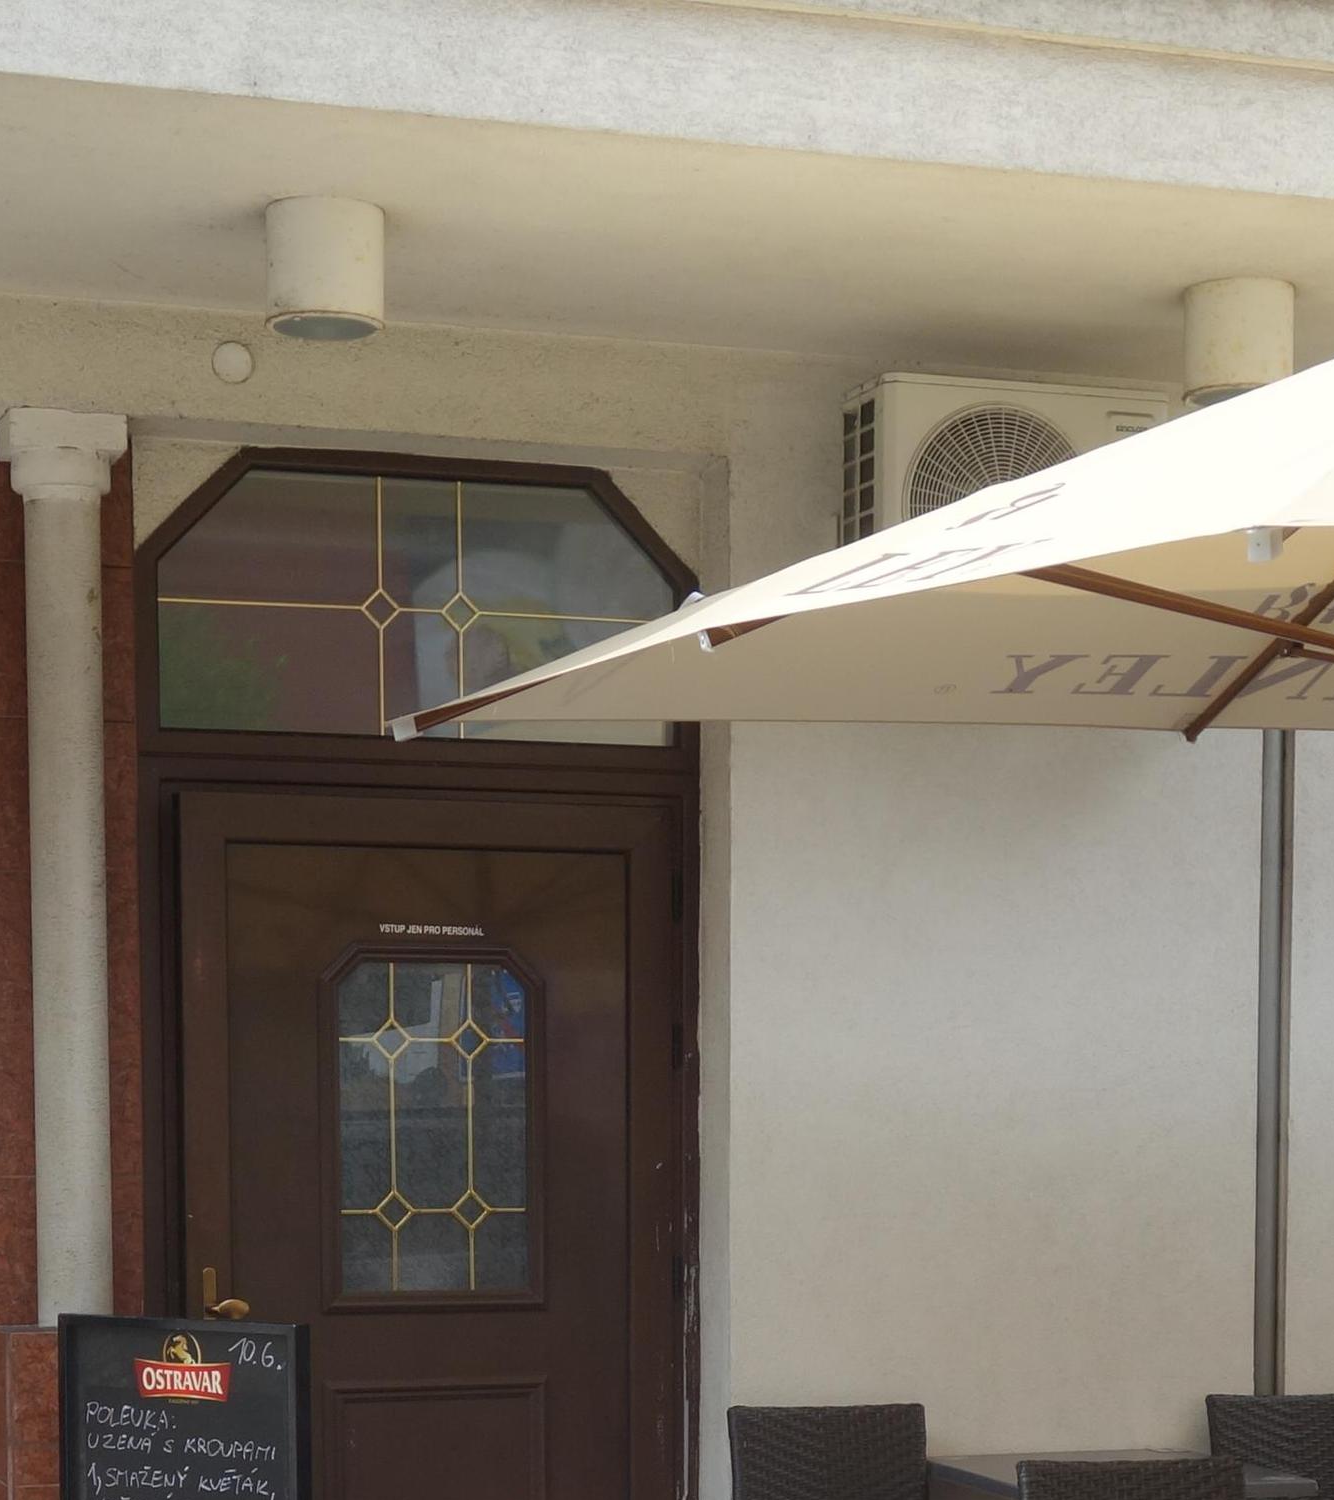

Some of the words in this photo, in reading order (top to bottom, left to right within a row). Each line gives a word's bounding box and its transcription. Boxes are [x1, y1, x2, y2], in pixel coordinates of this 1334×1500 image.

[379, 923, 405, 933] VSTUP
[406, 924, 422, 934] JEN
[424, 925, 441, 935] PRO
[442, 925, 485, 937] PERSONÁL
[228, 1337, 283, 1370] 10.6.
[142, 1366, 224, 1395] OSTRAVAR
[184, 1438, 276, 1460] KROUPAMI
